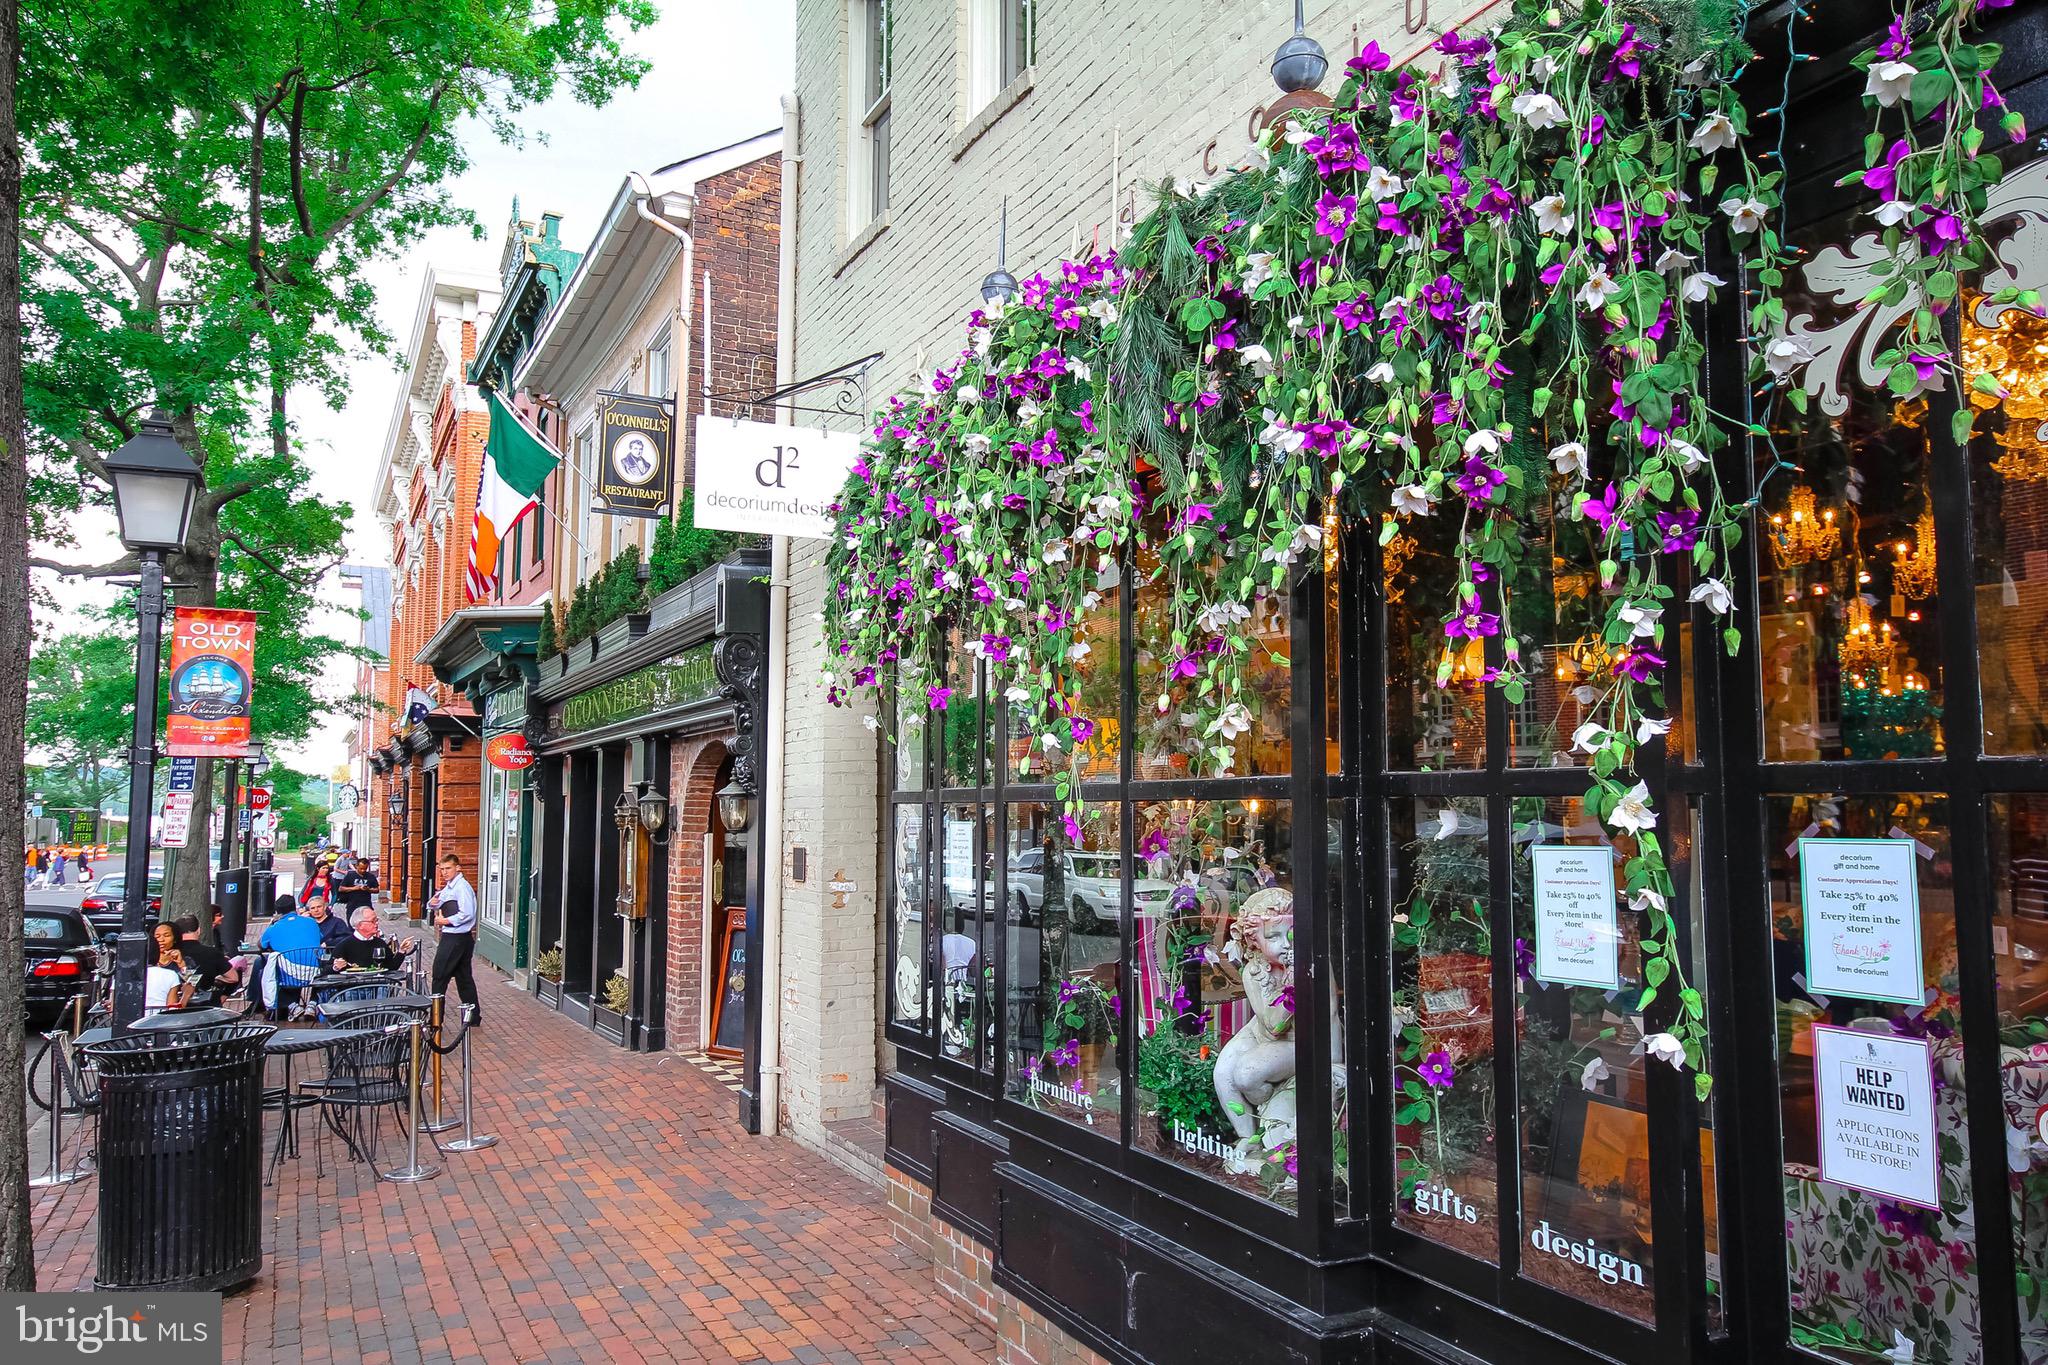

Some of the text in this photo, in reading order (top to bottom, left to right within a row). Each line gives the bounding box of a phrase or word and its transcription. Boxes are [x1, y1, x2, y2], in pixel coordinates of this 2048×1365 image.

[606, 412, 668, 432] O'CONNELL'S
[605, 485, 664, 500] RESTAURANT
[190, 622, 241, 636] OLD
[177, 635, 251, 651] TOWN
[562, 657, 715, 729] O'CONNELL'S RESTAURA
[500, 747, 533, 756] Radianc
[509, 756, 527, 764] Yoga
[252, 795, 269, 804] TOP
[1546, 891, 1562, 899] Take
[1563, 892, 1577, 900] 25%
[1586, 893, 1601, 901] 40%
[1819, 890, 1841, 899] Take
[1844, 892, 1863, 901] 25%
[1878, 893, 1898, 902] 40%
[1569, 901, 1578, 909] off
[1852, 903, 1866, 911] off
[1547, 910, 1564, 919] Every
[1566, 911, 1582, 919] item
[1591, 912, 1602, 920] the
[1821, 912, 1900, 925] Every item in the
[1565, 920, 1584, 928] store!
[1847, 925, 1874, 934] store!
[1835, 944, 1883, 958] Thank You
[1570, 957, 1594, 965] decorium!
[1837, 965, 1888, 976] from decorium!
[1856, 1067, 1893, 1089] HELP
[1030, 1071, 1093, 1110] furniture
[1846, 1085, 1905, 1111] WANTED
[1836, 1118, 1920, 1143] APPLICATIONS
[1173, 1118, 1247, 1167] lighting
[1836, 1132, 1920, 1158] AVAILABLE IN
[1845, 1147, 1912, 1171] THE STORE!
[1414, 1184, 1478, 1224] gifts
[1531, 1220, 1645, 1287] design
